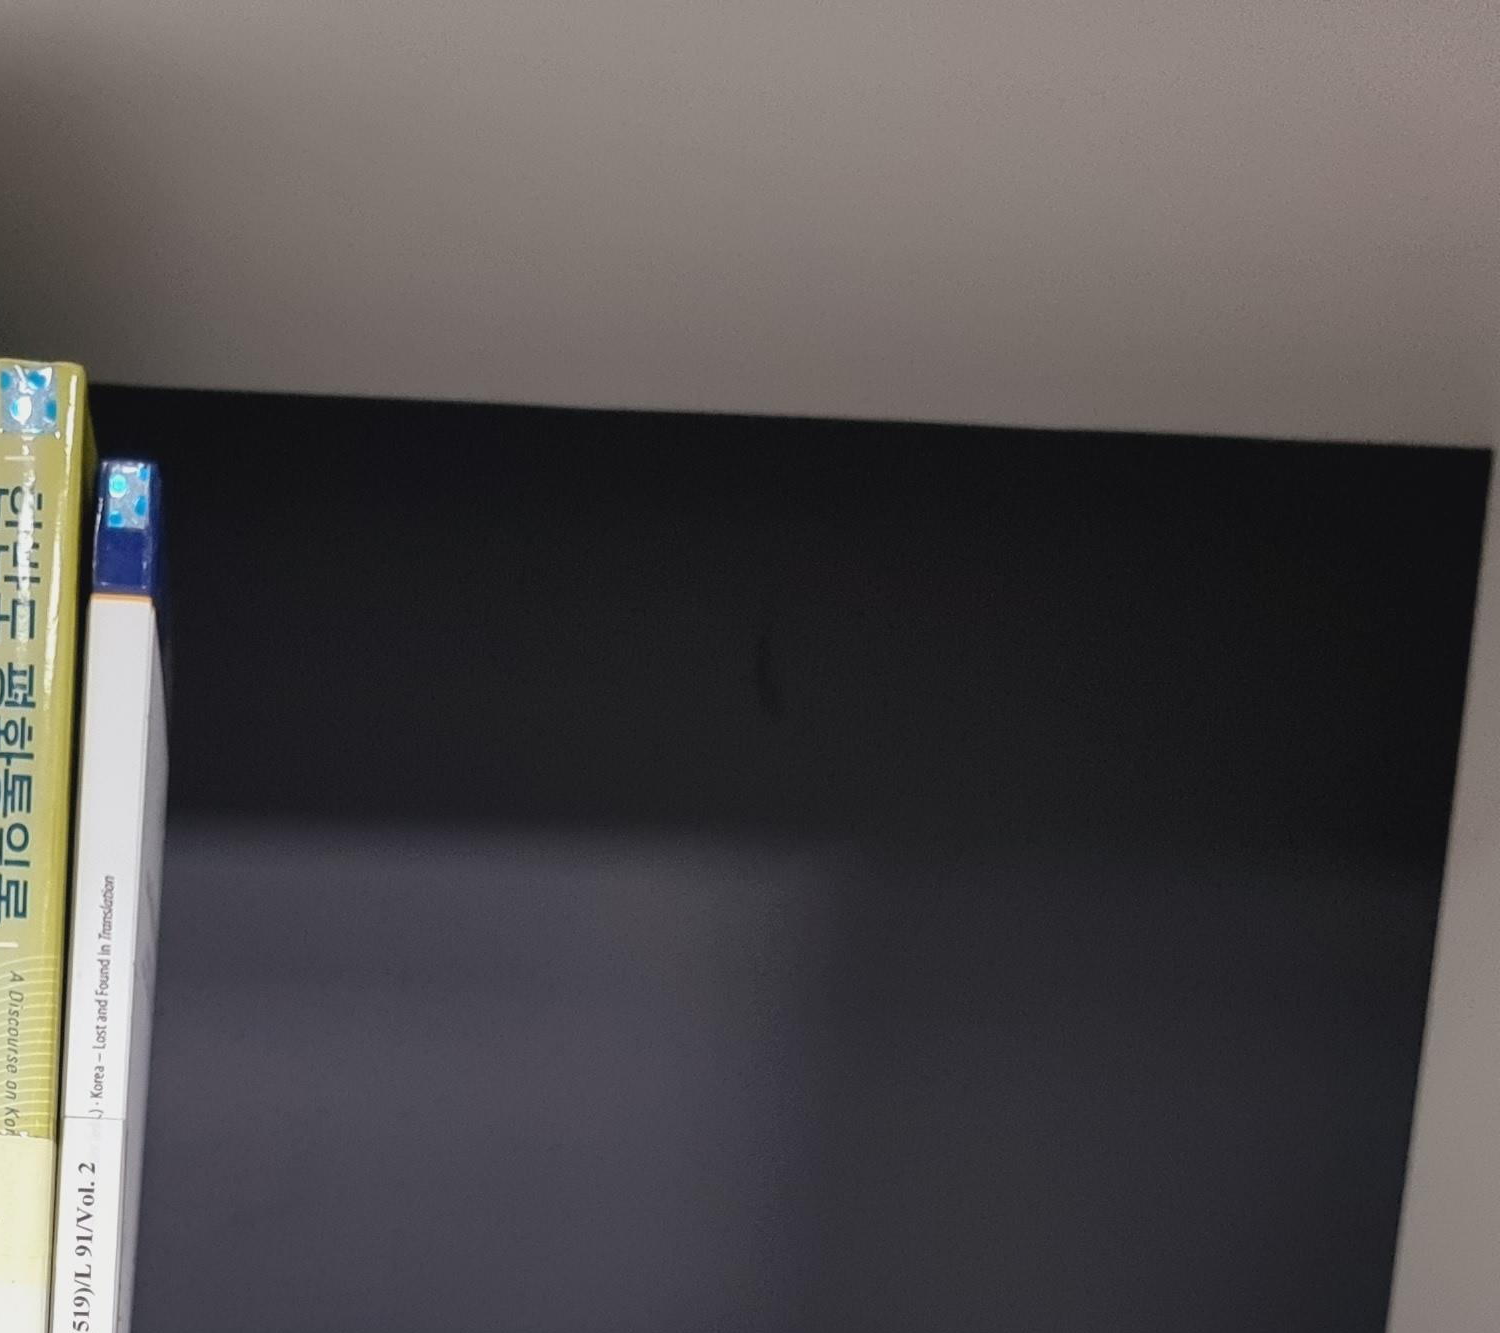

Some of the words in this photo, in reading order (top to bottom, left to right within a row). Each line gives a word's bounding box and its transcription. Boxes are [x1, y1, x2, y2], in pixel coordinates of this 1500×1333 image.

[99, 875, 115, 942] Translation
[6, 990, 24, 1074] Discourse
[75, 1180, 94, 1257] 91/Vol.
